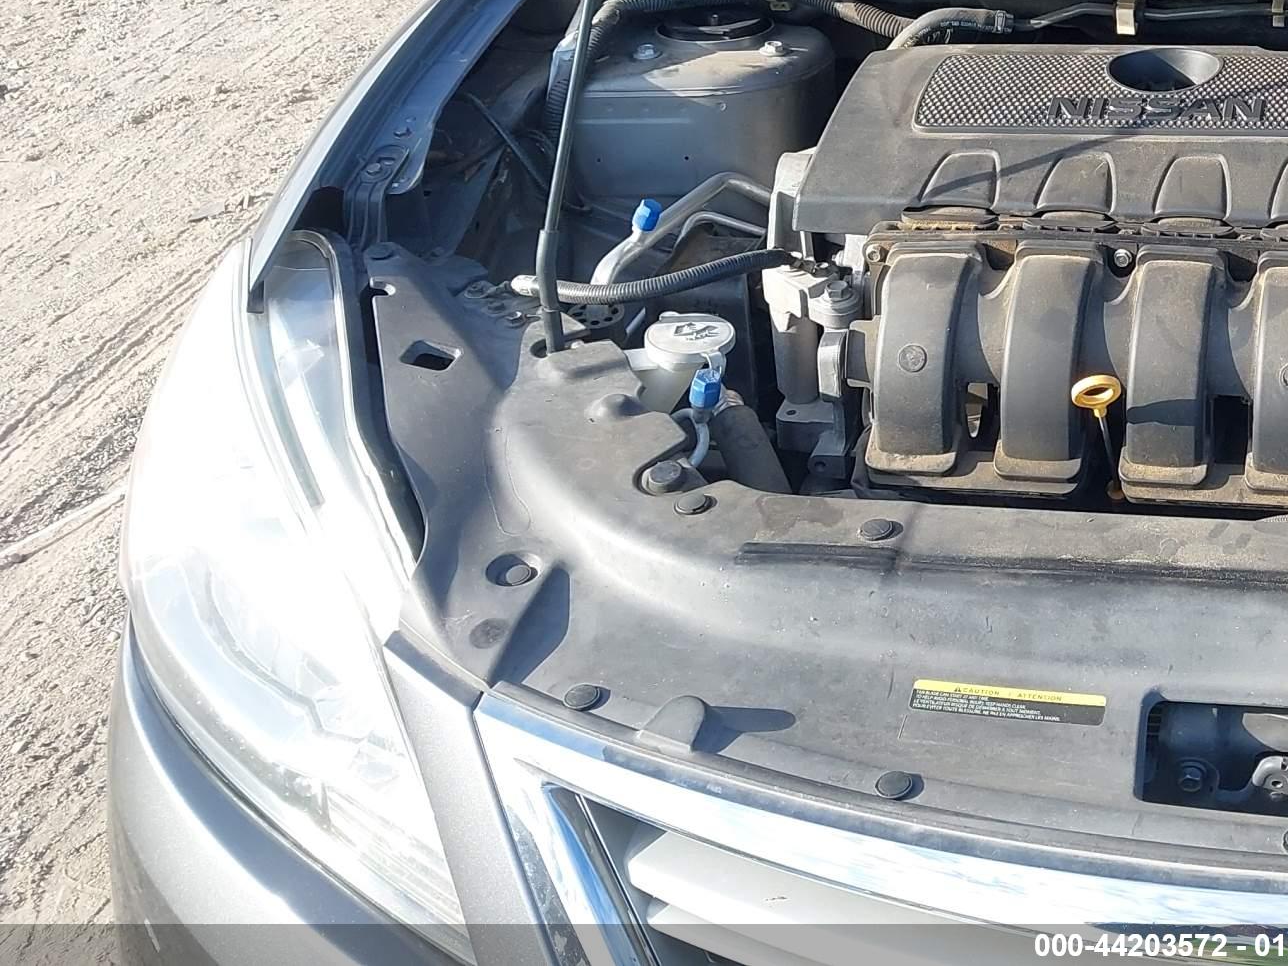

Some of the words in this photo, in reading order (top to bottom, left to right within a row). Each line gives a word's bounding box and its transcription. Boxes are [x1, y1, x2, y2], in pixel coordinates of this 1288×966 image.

[1047, 97, 1267, 122] NISSAN
[962, 687, 999, 696] CAUTION
[1017, 692, 1062, 702] ATTENTION
